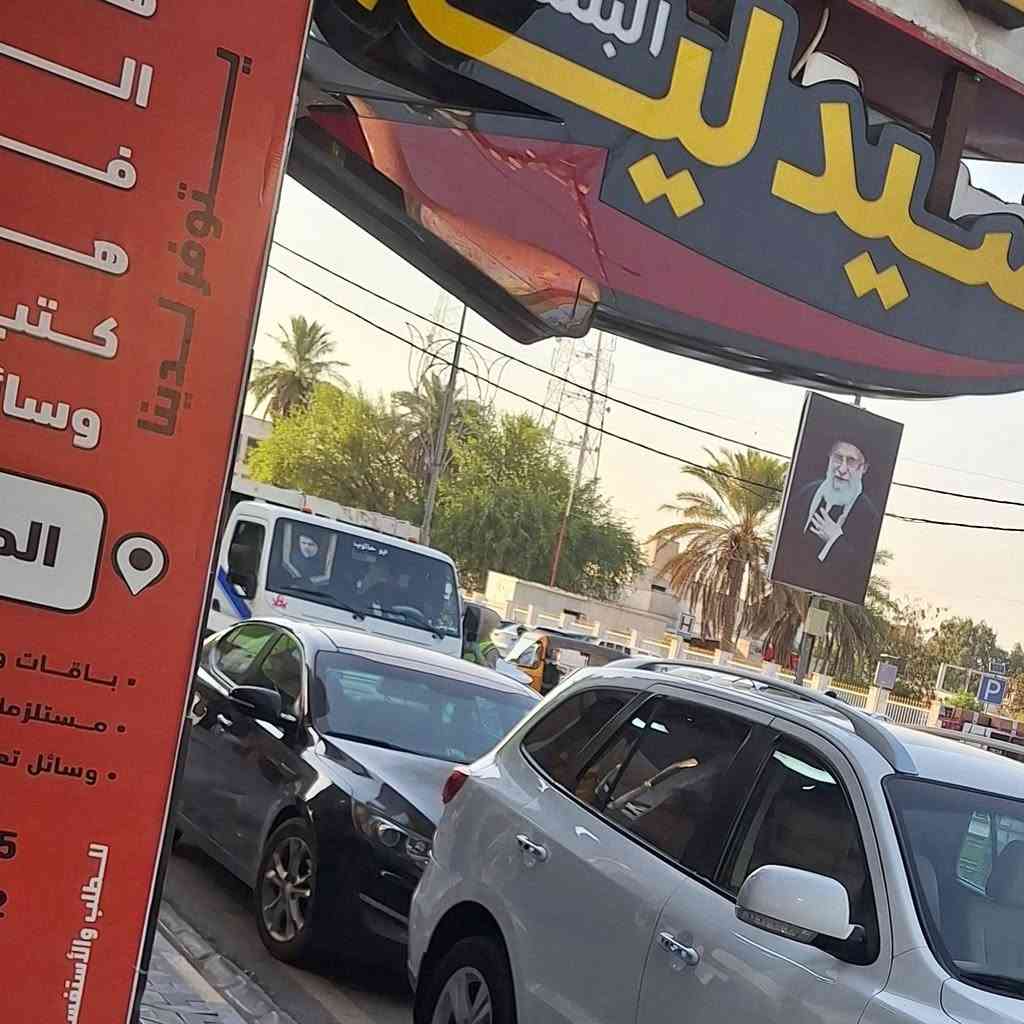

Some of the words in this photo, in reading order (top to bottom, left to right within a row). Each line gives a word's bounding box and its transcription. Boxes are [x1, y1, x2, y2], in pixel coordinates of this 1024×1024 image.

[137, 297, 196, 437] لدينا
[16, 653, 118, 692] باقات
[27, 753, 98, 785] وسائل
